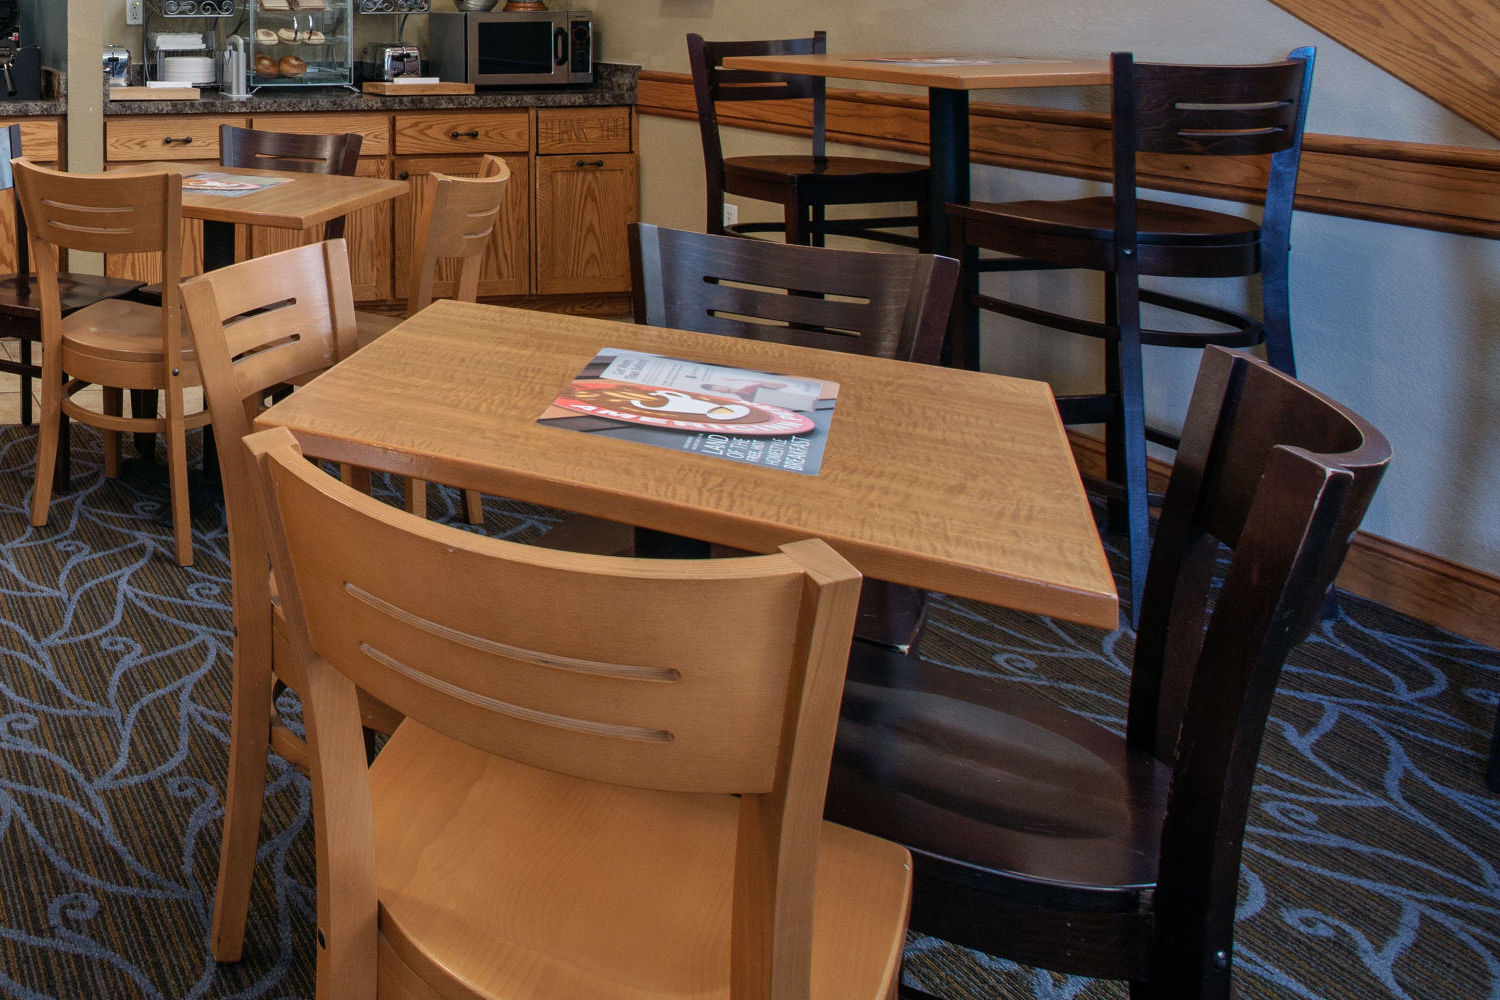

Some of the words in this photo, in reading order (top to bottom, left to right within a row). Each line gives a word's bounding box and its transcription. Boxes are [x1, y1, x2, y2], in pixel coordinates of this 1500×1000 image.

[701, 434, 729, 456] LAND
[725, 447, 746, 459] OF
[729, 437, 750, 450] THE
[764, 437, 787, 466] HOMESTYLE
[783, 435, 810, 471] BREAKFAST
